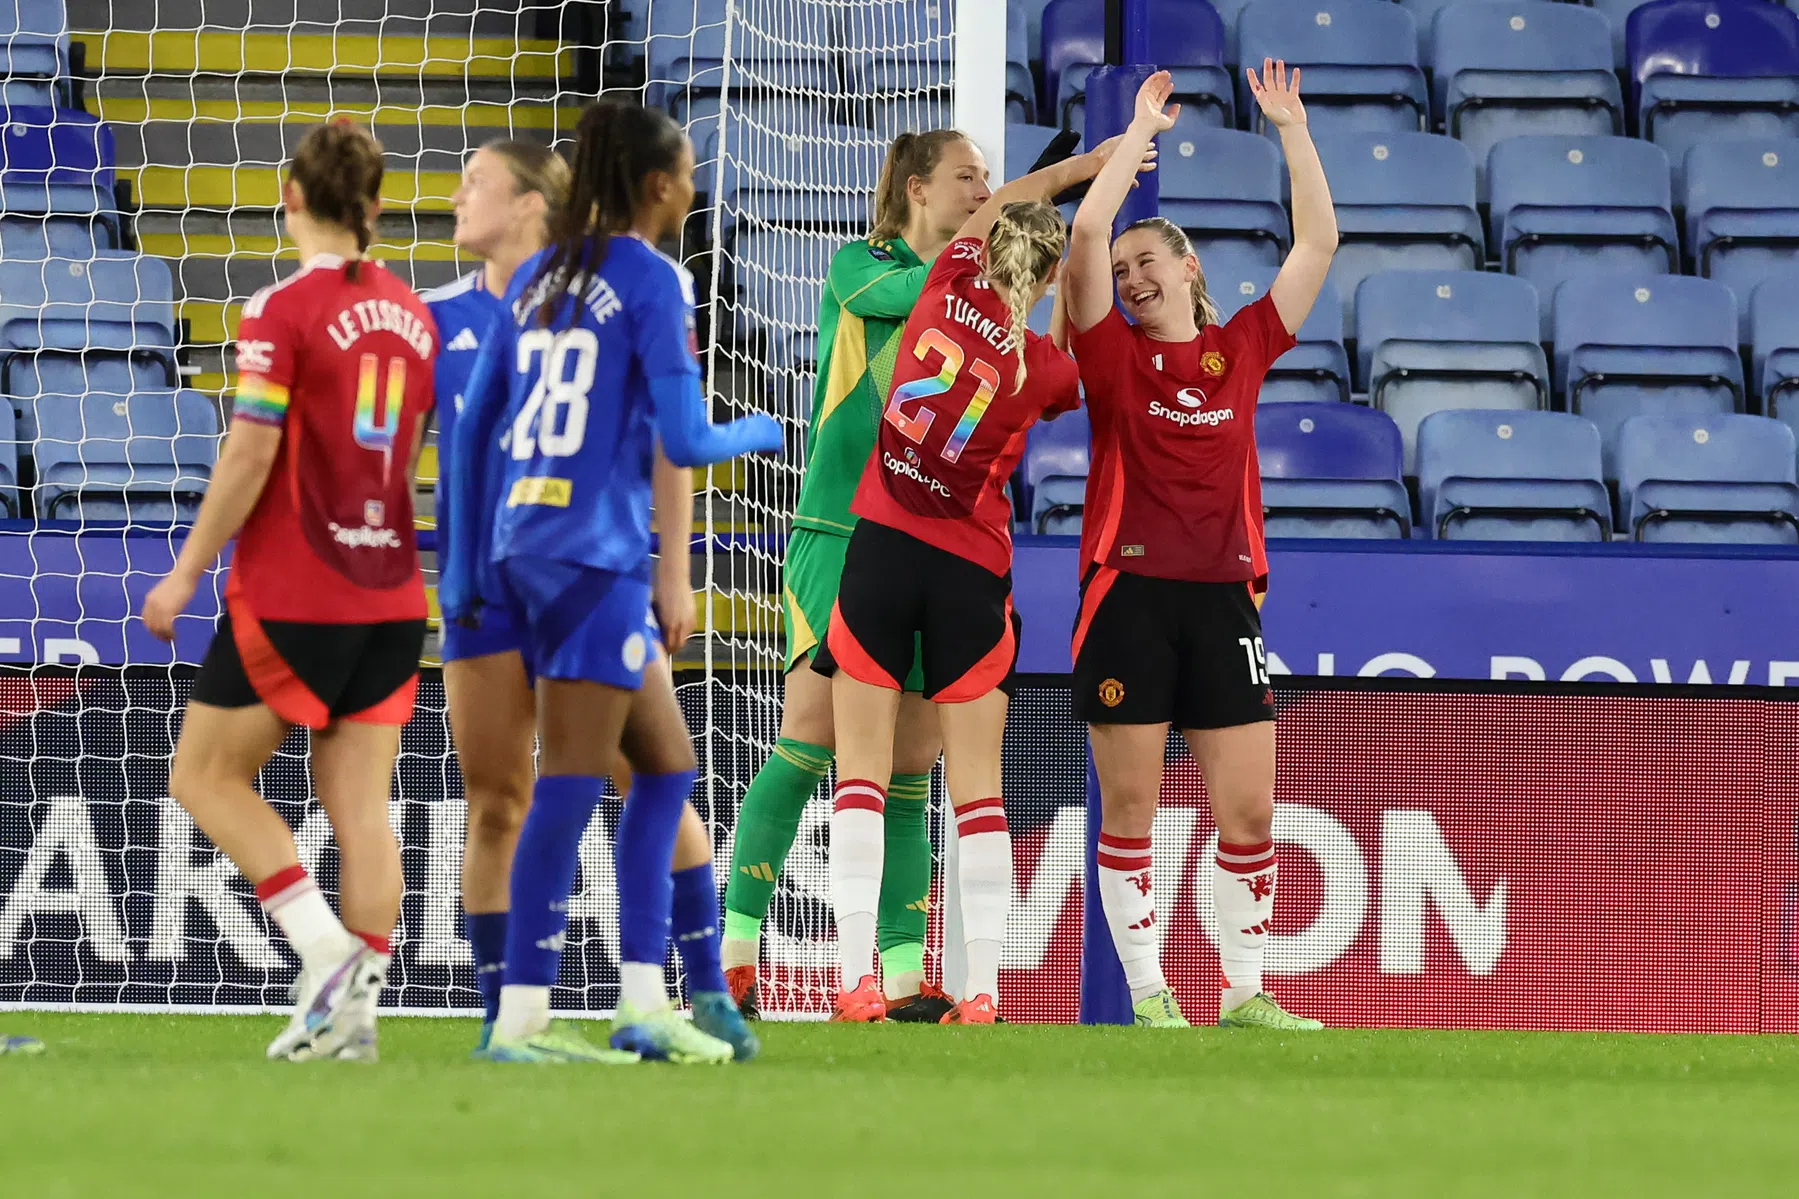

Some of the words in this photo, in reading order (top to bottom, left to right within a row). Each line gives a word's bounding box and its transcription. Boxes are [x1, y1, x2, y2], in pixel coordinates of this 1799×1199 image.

[945, 294, 1017, 356] TURNER
[352, 352, 406, 489] 4
[511, 328, 599, 461] 28
[1148, 400, 1234, 427] Snapdragon
[1238, 636, 1270, 685] 19
